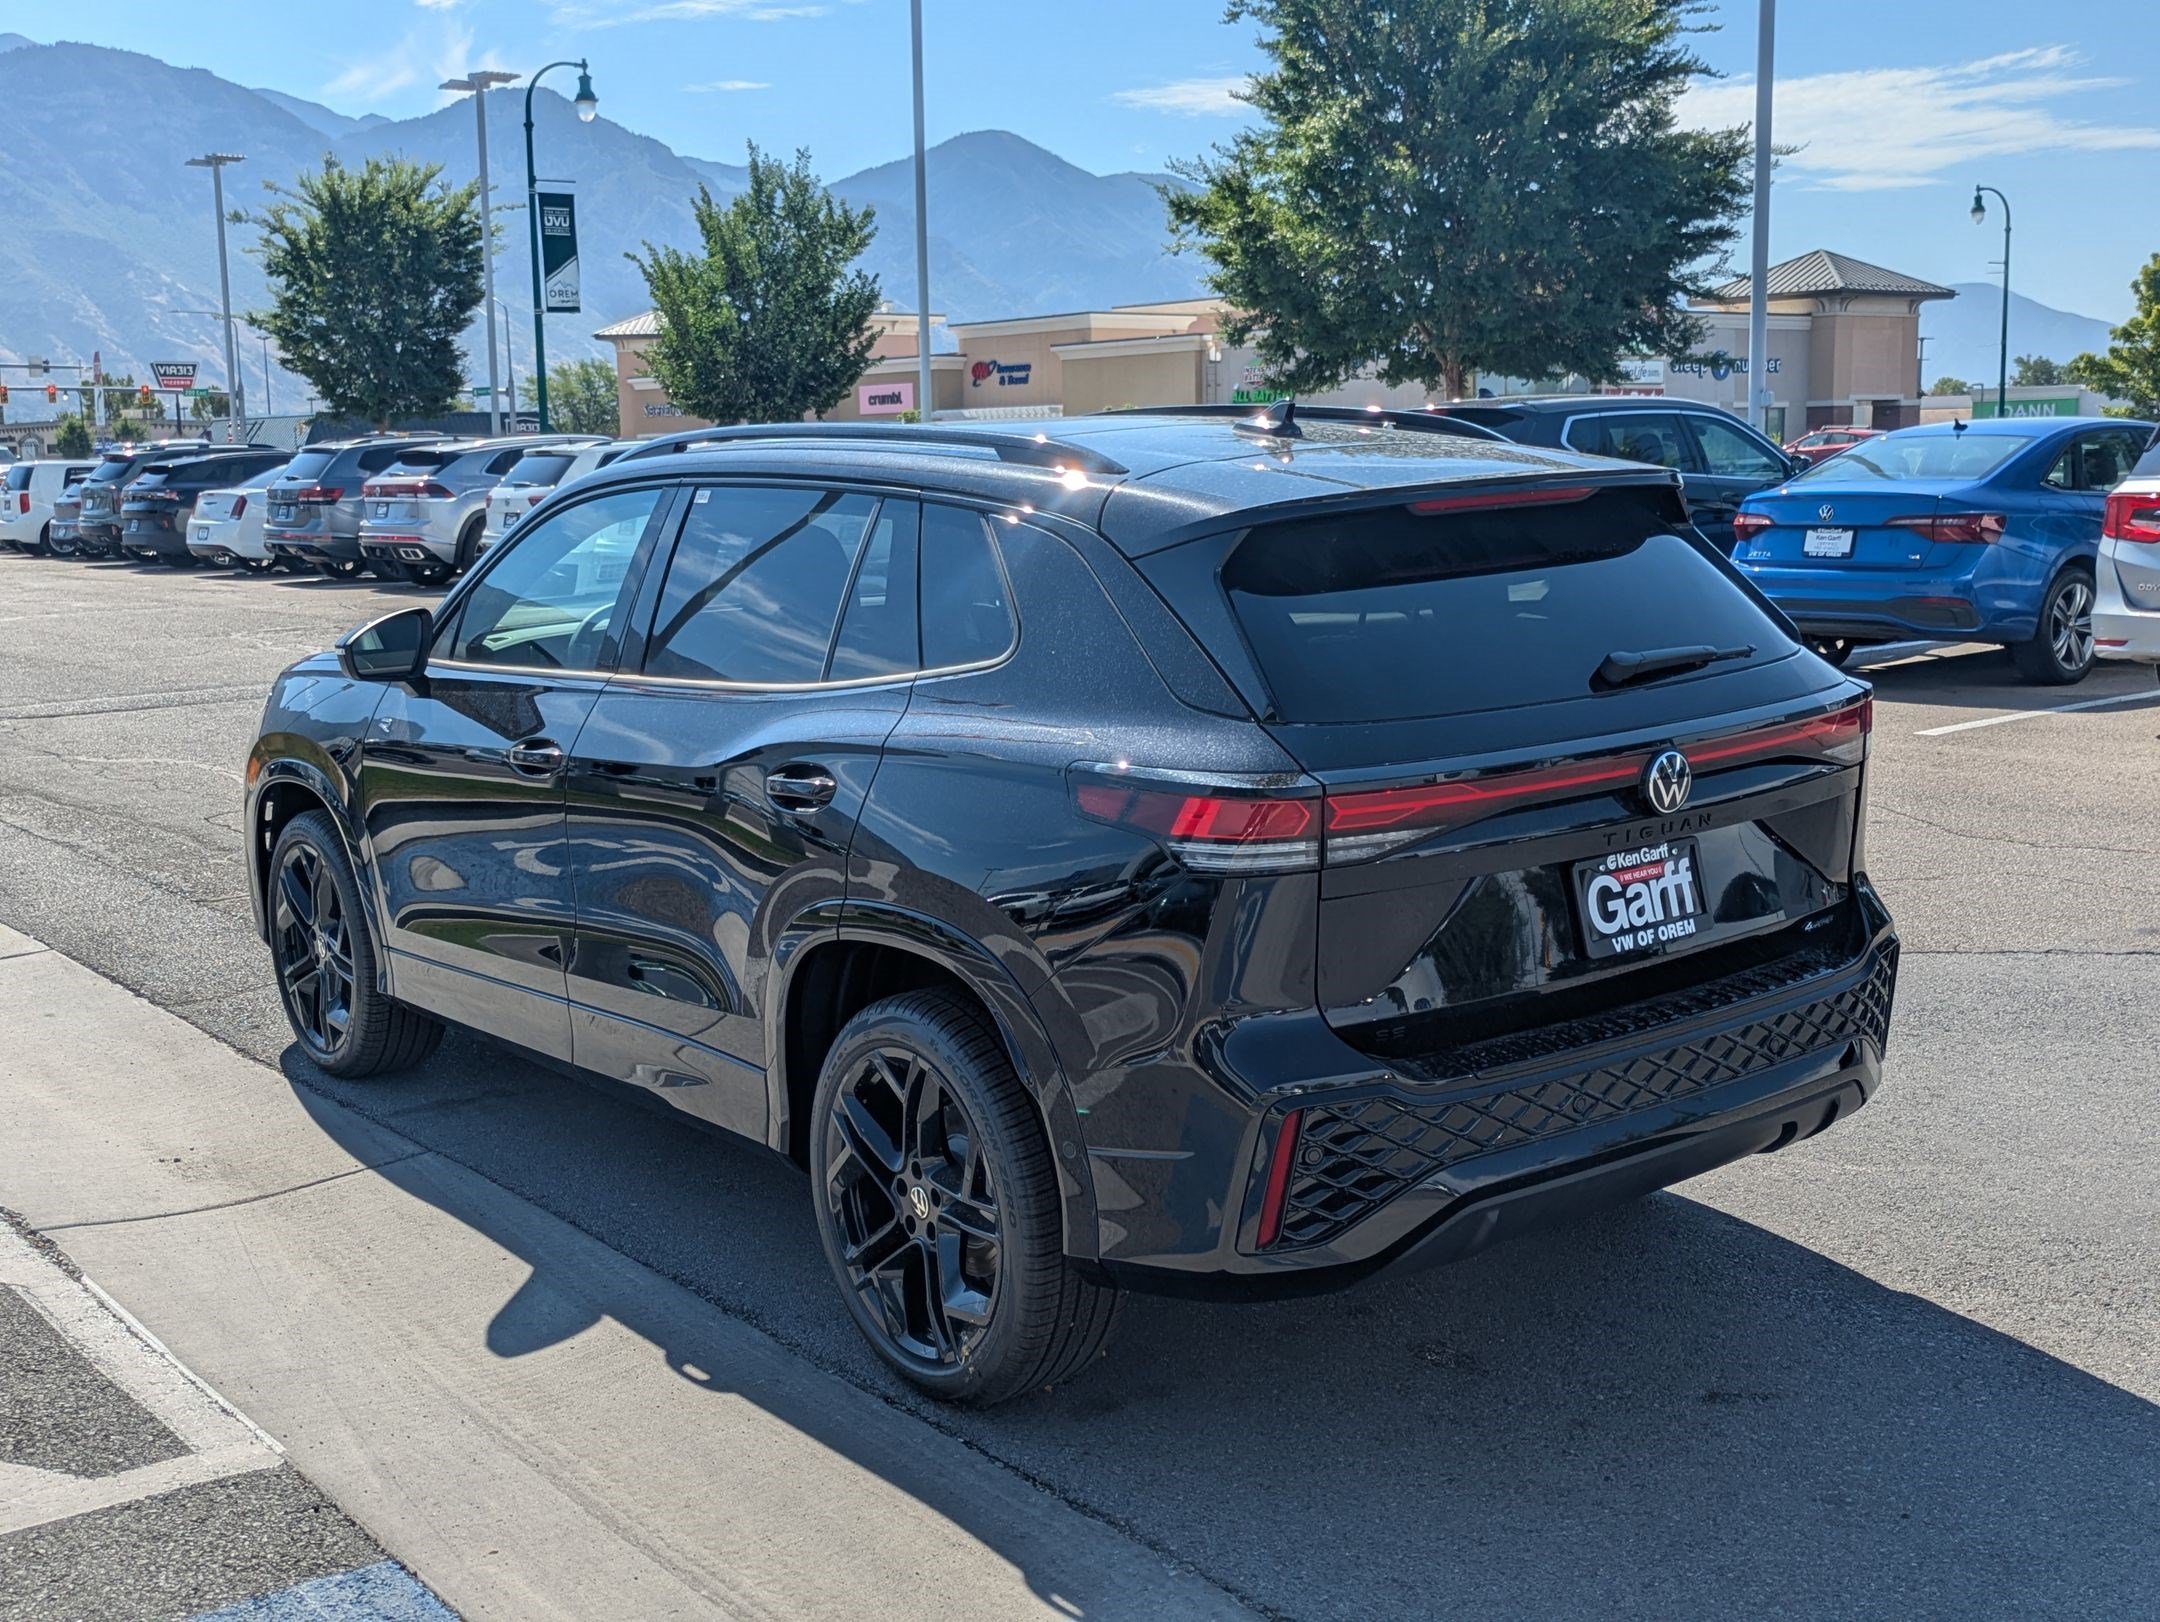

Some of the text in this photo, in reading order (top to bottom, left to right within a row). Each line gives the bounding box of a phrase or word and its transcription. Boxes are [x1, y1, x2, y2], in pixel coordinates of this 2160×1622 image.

[544, 216, 570, 227] UVU
[549, 289, 579, 299] OREM
[1732, 357, 1781, 373] nuer
[868, 391, 903, 406] crumbl
[1603, 813, 1712, 846] TIGUAN
[1617, 843, 1669, 869] Ken Garff
[1623, 867, 1659, 881] WE HEAR YOU
[1588, 857, 1695, 935] Garff
[1612, 919, 1697, 953] VW OF OREM
